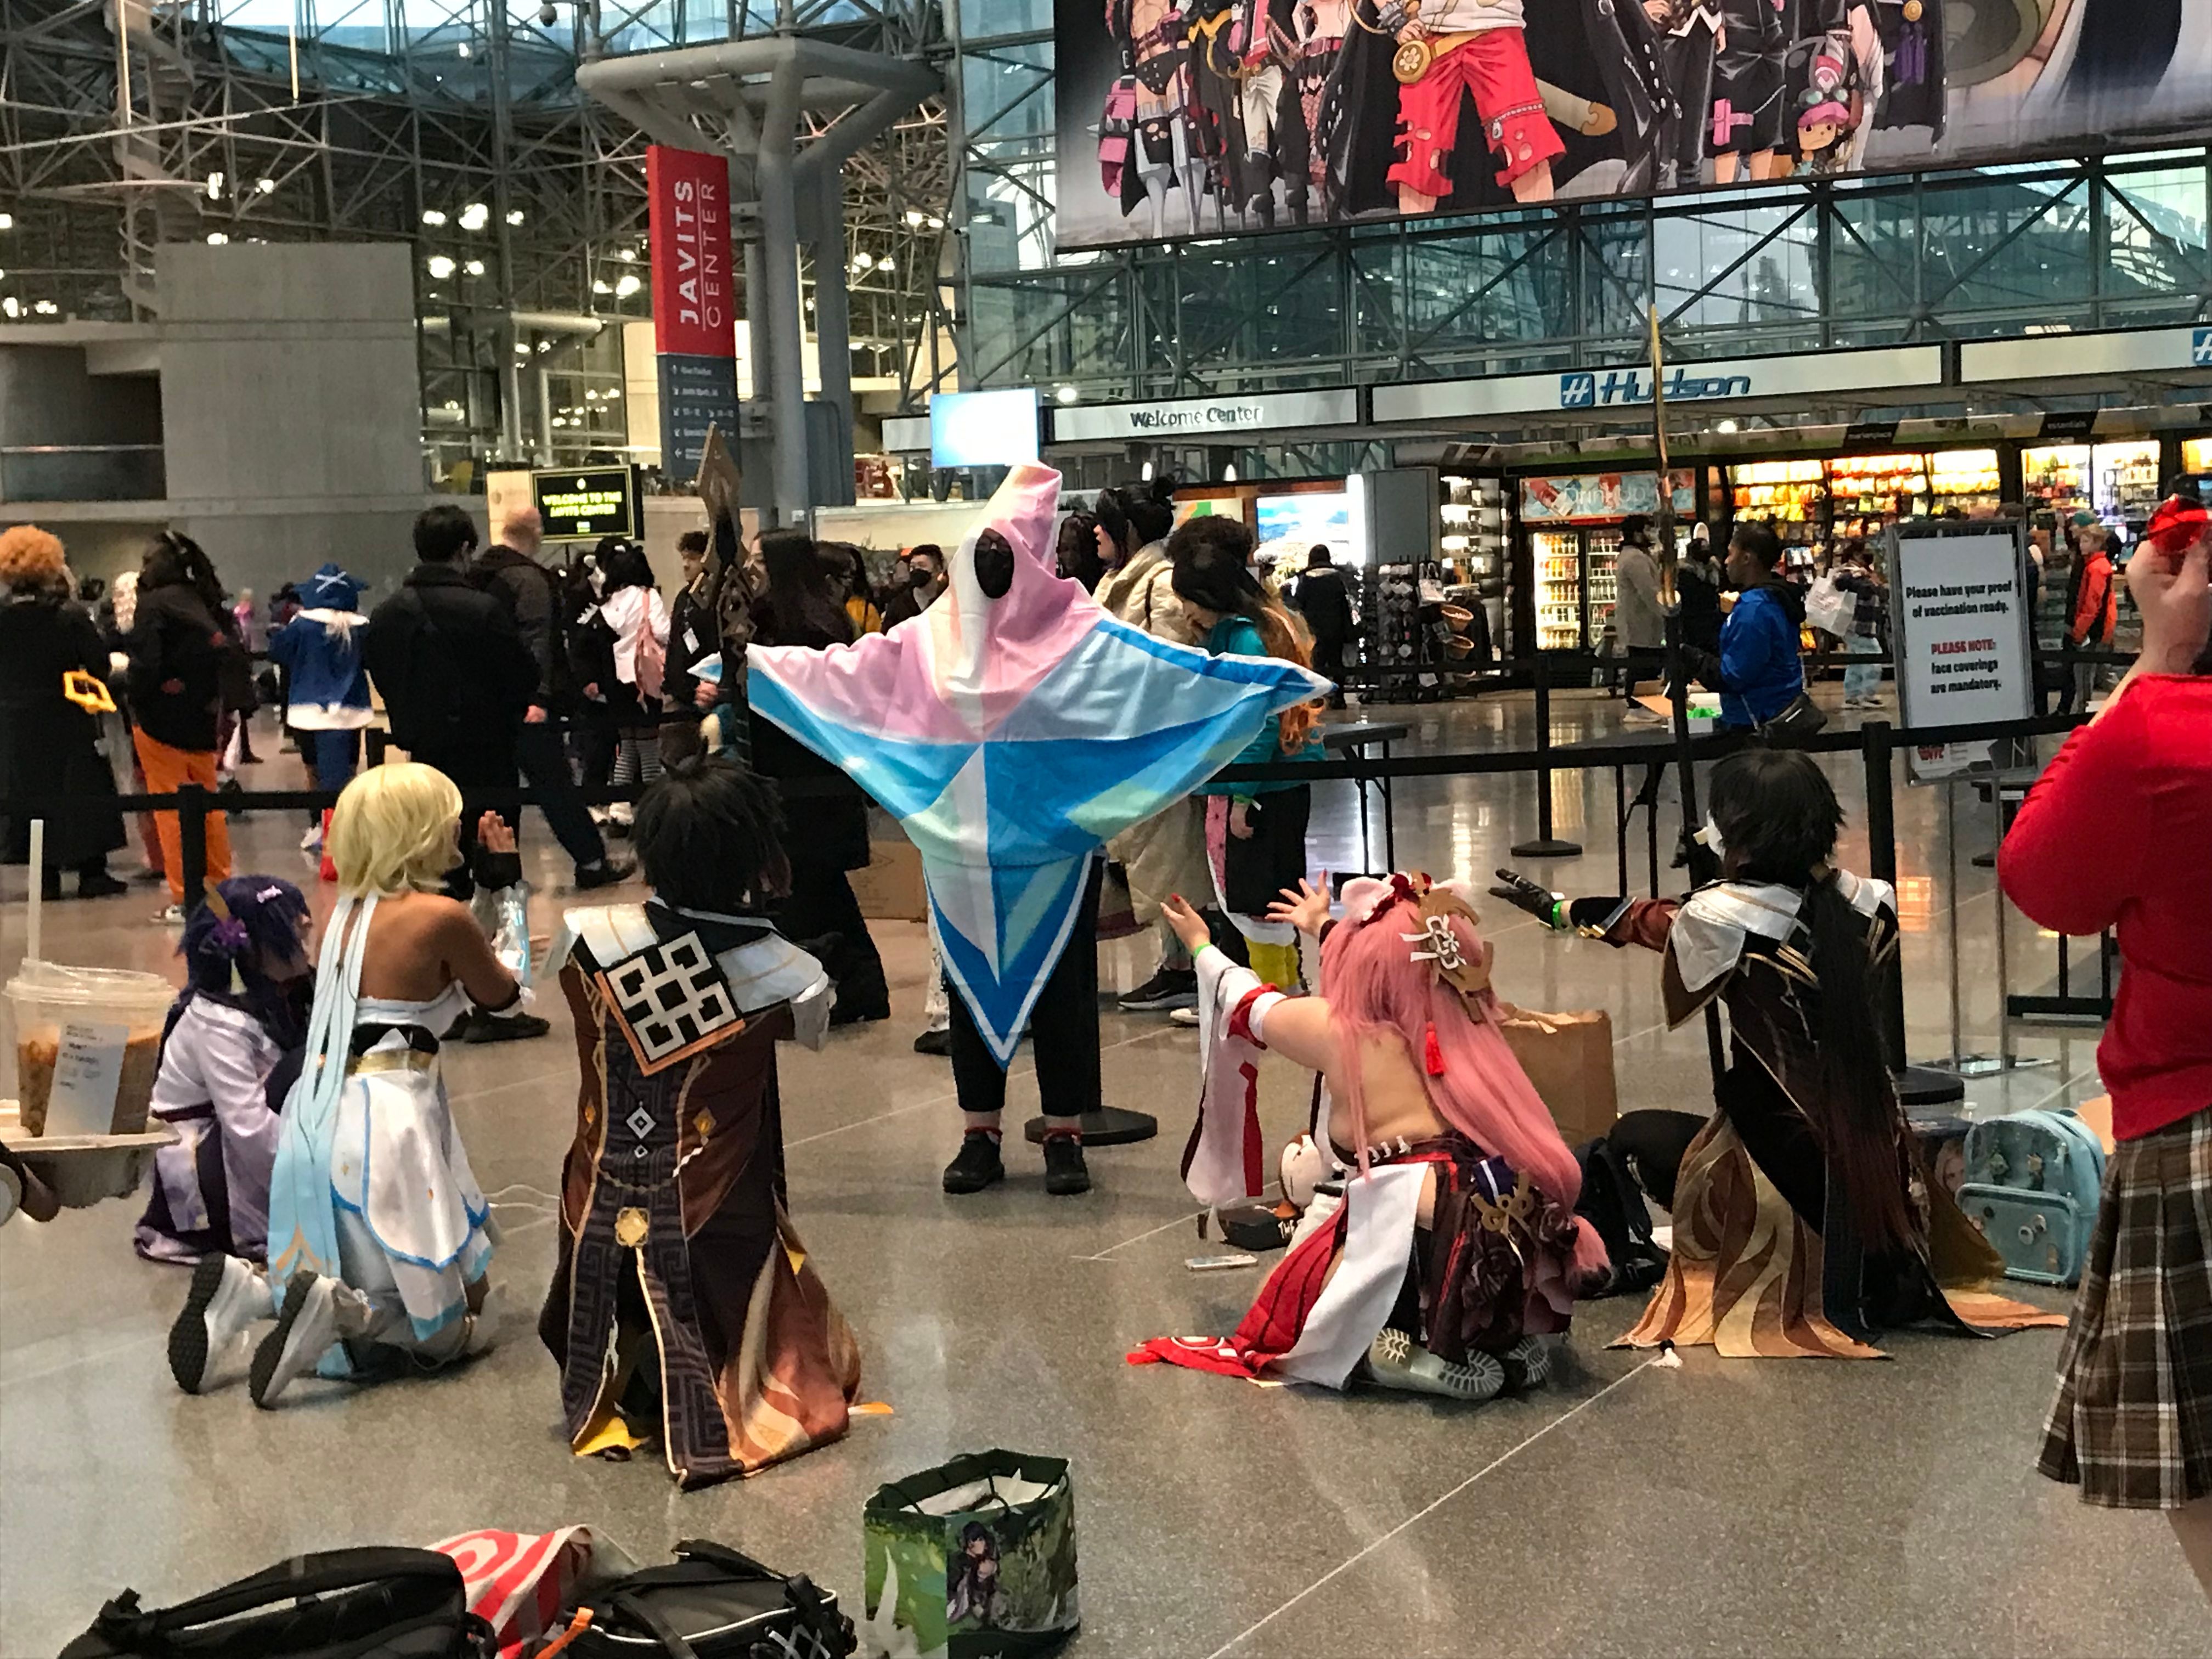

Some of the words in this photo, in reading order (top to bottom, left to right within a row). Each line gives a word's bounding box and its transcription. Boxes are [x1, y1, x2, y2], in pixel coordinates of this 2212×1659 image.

[674, 180, 699, 325] JAVITS
[701, 183, 721, 328] CENTER
[1600, 368, 1751, 404] Hudson
[1130, 409, 1203, 428] Welcome
[1206, 405, 1261, 424] Center
[542, 493, 588, 505] WELCOME
[589, 492, 602, 503] TO
[603, 491, 622, 503] THE
[580, 504, 616, 516] CENTER
[1906, 586, 1938, 599] Please
[1940, 584, 1963, 596] have
[1964, 584, 1985, 598] your
[1988, 580, 2012, 596] proof
[1912, 605, 1922, 618] of
[1924, 601, 1978, 617] vaccination
[1979, 600, 2009, 614] ready.
[1931, 641, 1967, 654] PLEASE
[1968, 638, 1996, 651] NOTE:
[1931, 662, 1951, 674] face
[1954, 658, 1998, 673] coverings
[1931, 684, 1946, 693] are
[1948, 678, 2002, 692] mandatory.
